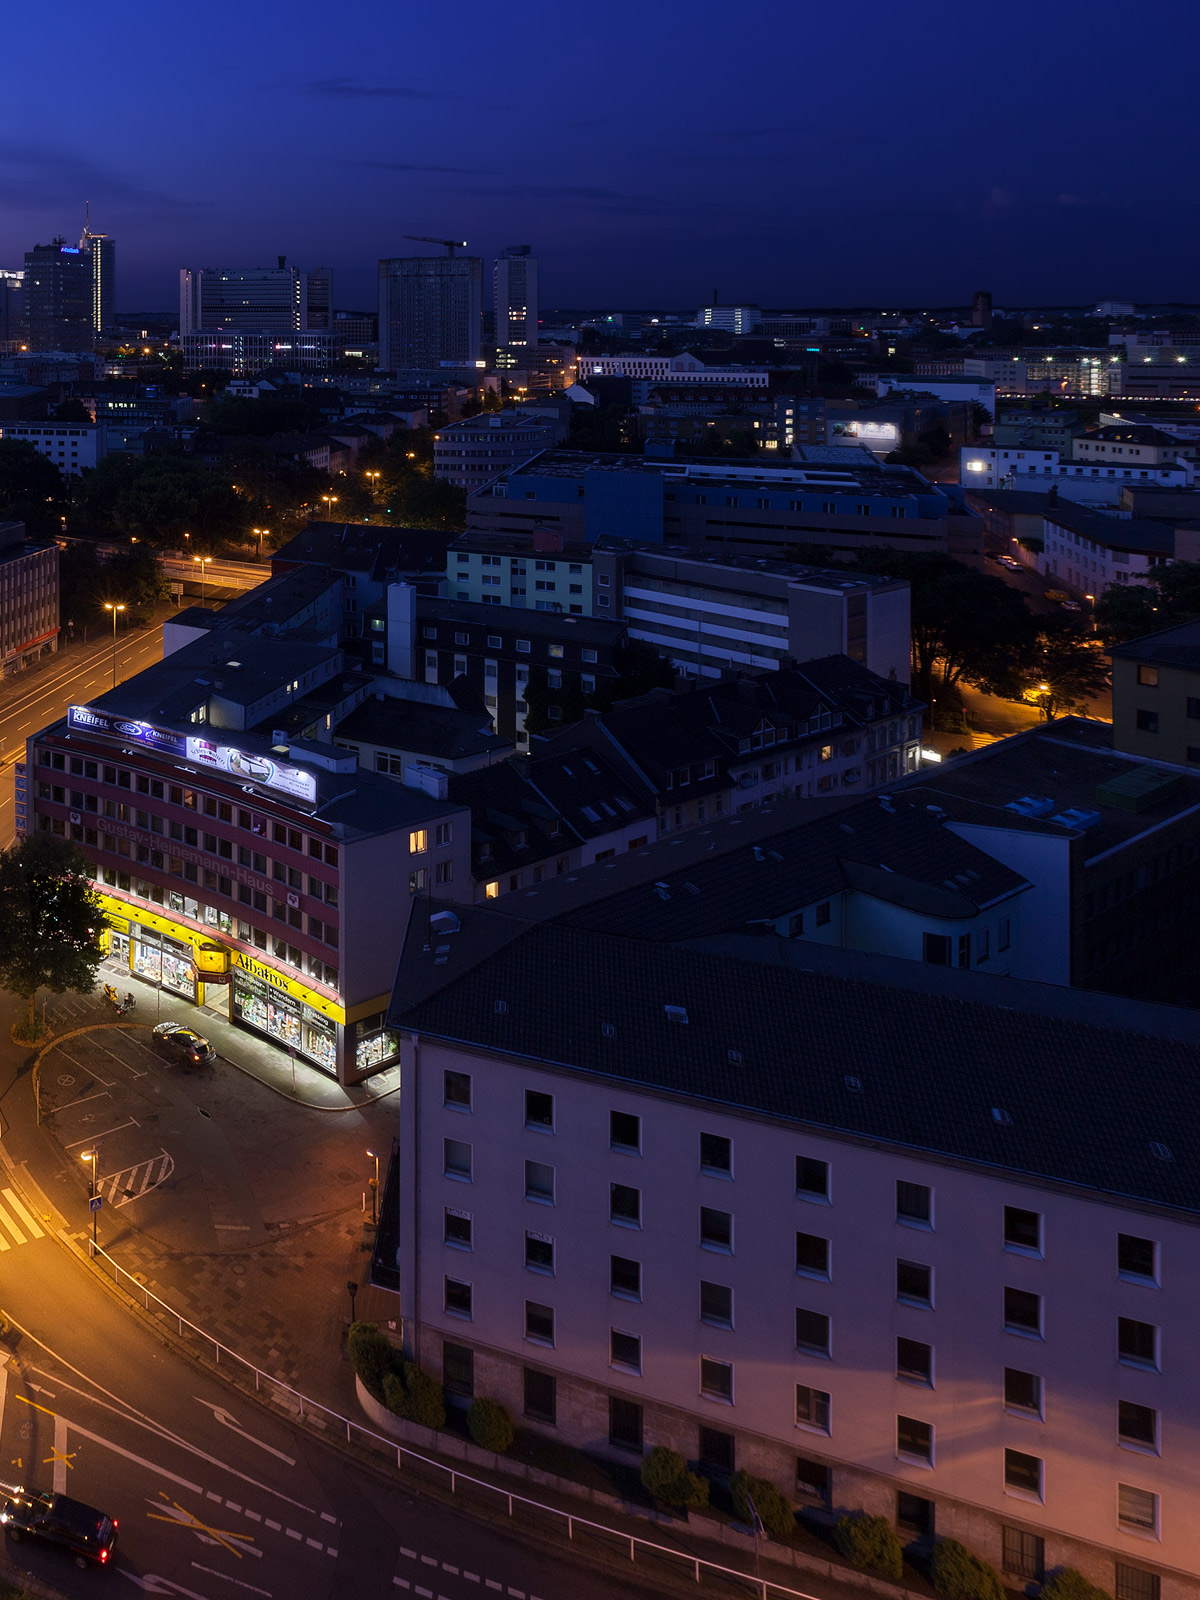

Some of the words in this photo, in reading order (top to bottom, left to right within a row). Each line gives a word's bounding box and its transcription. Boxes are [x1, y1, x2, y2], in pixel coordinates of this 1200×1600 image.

[73, 711, 109, 727] KNEIFEL
[152, 730, 178, 743] KNEIFEL
[16, 779, 26, 829] CVJM
[96, 818, 274, 895] Gustav-Heinemann-Haus
[235, 953, 290, 992] Albatros
